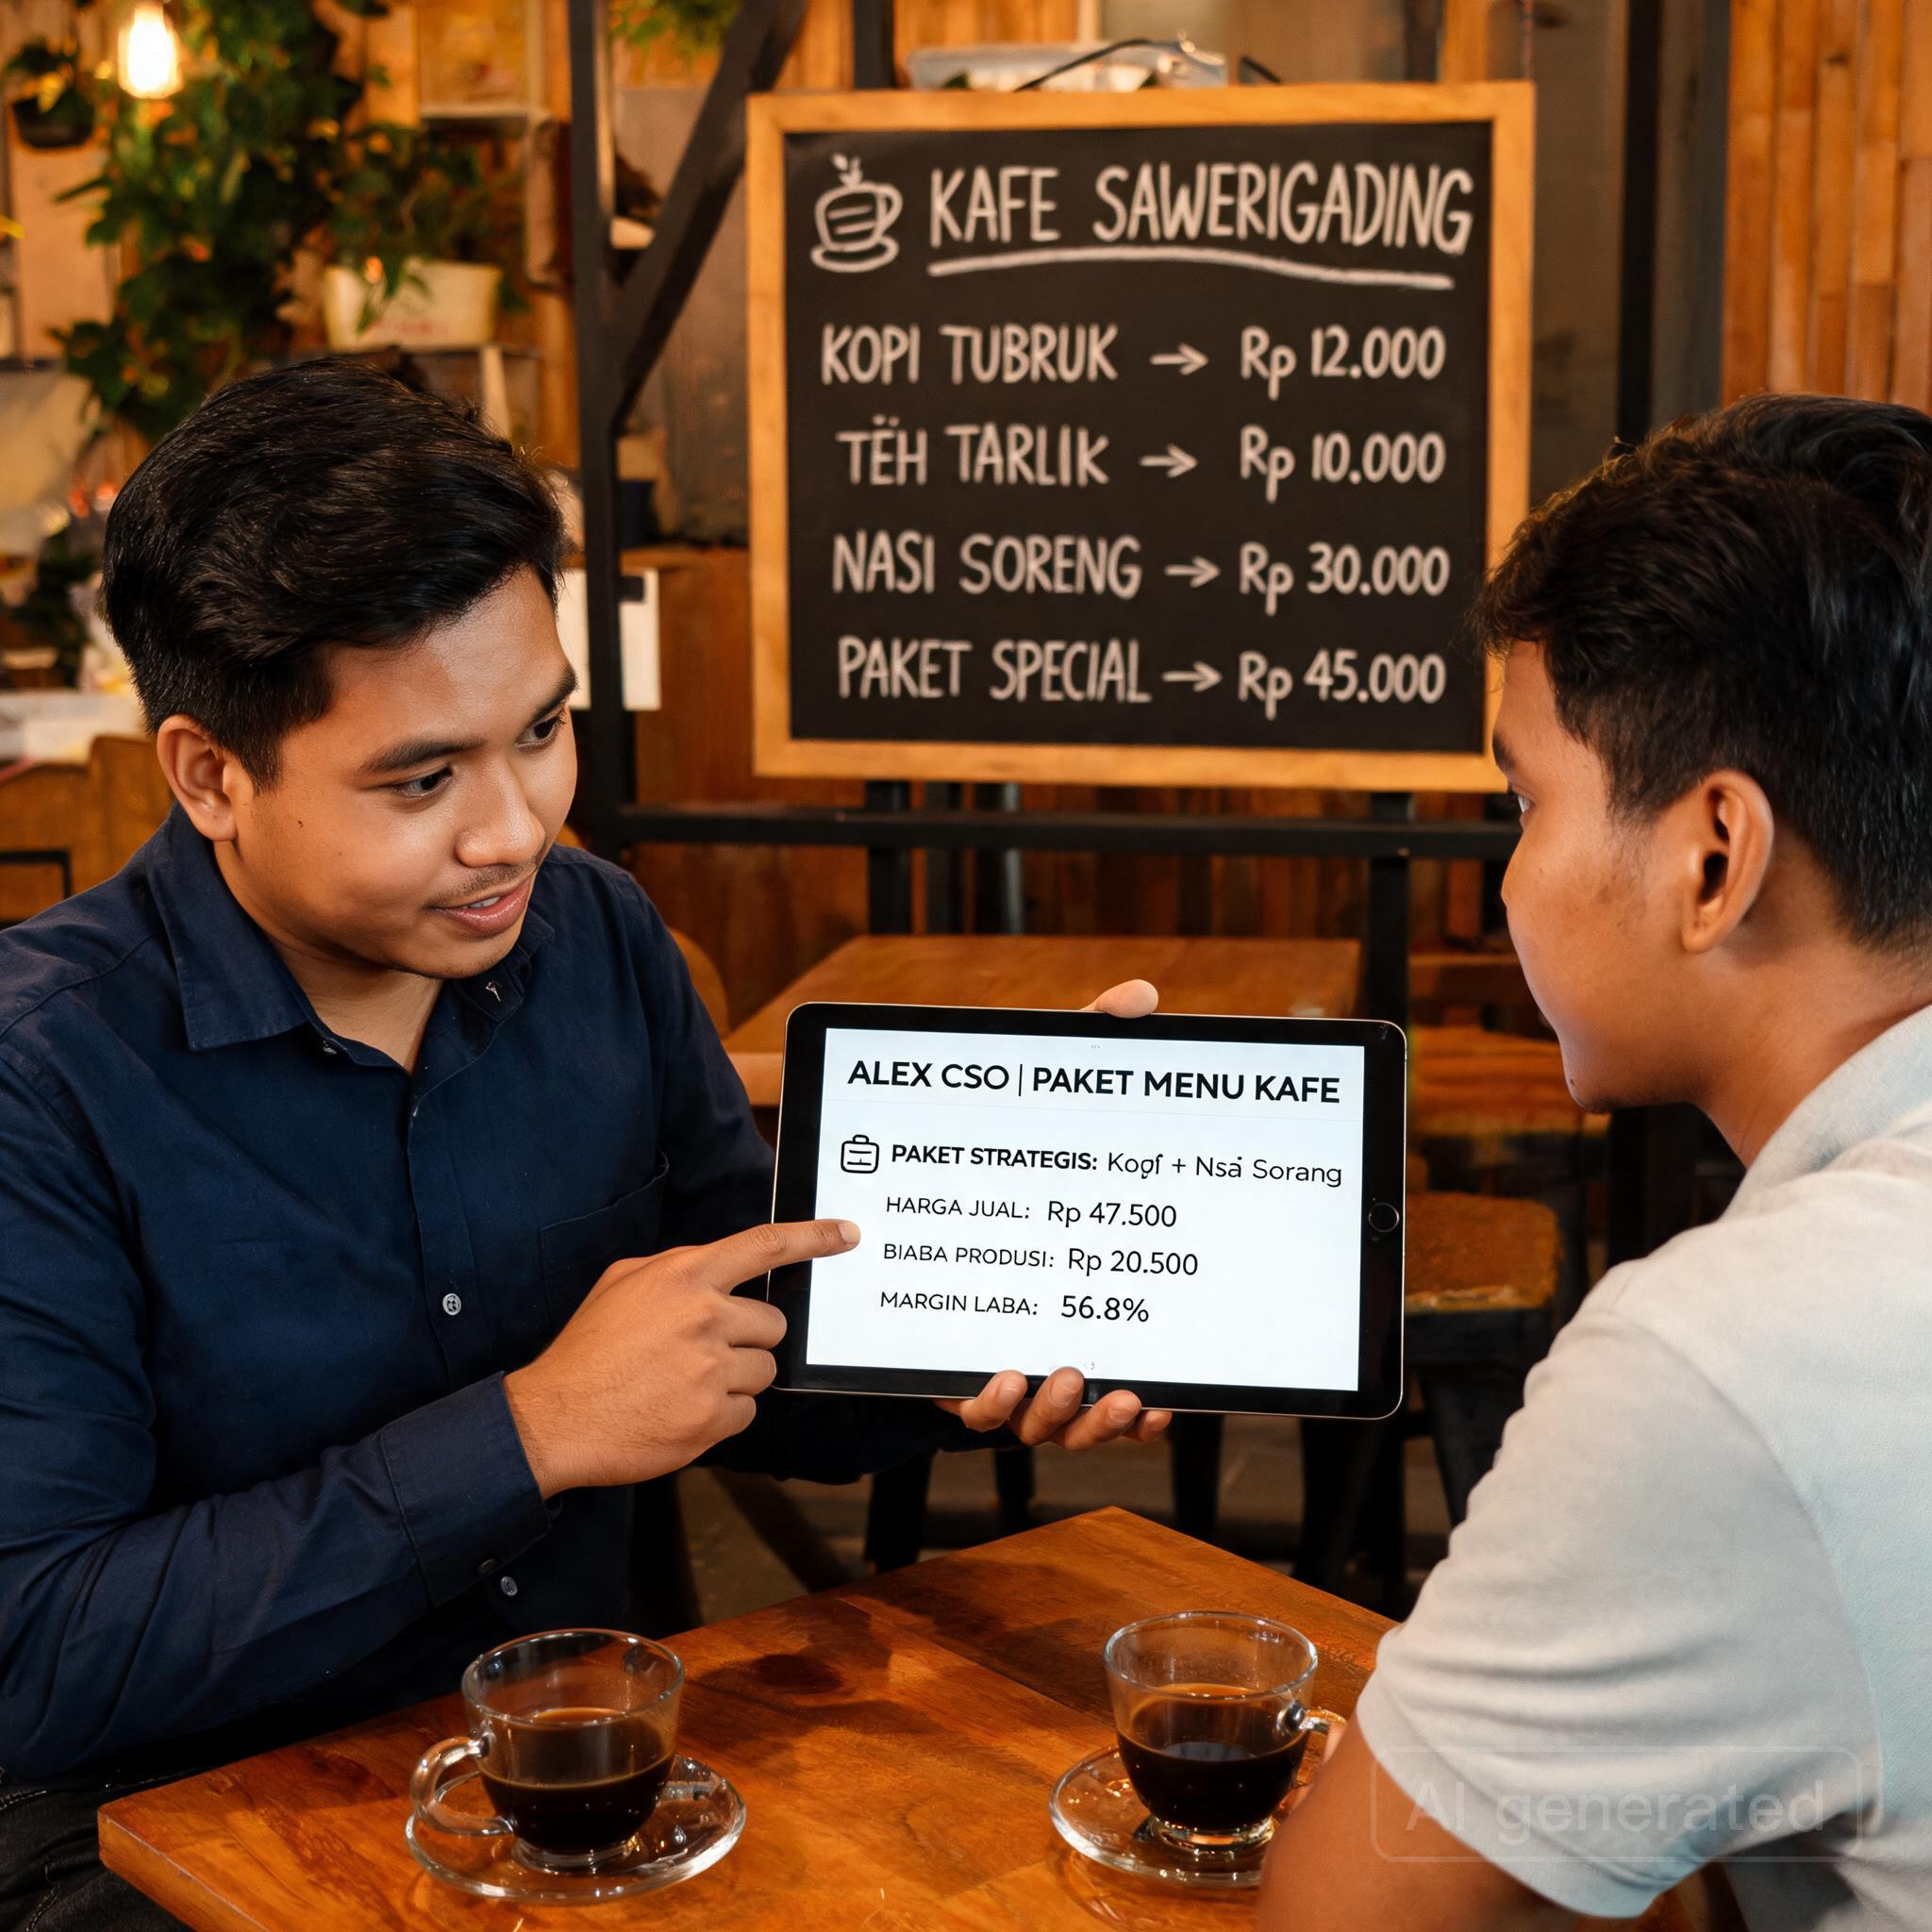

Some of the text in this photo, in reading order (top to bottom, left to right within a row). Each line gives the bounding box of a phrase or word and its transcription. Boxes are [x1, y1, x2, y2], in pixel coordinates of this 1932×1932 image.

[931, 161, 1473, 255] KAFE SAWERIGADING
[821, 324, 1446, 401] KOPI TUBRUK Rp 12.000
[945, 423, 1109, 486] TARLIK
[1241, 425, 1295, 503] Rp
[1311, 431, 1446, 484] 10.000
[832, 530, 1451, 616] NASI SORENG Rp 30.000
[838, 638, 1446, 720] PAKET SPECIAL Rp 45.000
[847, 1059, 934, 1089] ALEX
[941, 1063, 1010, 1091] CSO
[1032, 1066, 1135, 1095] PAKET
[1143, 1070, 1245, 1100] MENU
[1255, 1074, 1341, 1104] KAFE
[891, 1143, 965, 1166] PAKET
[970, 1147, 1098, 1172] STRATEGIS:
[1252, 1158, 1343, 1189] Sorang
[886, 1196, 1177, 1228] HARGA JUAL: Rp 47.500
[883, 1243, 1198, 1277] BIABA PRODUSI: Rp 20.500
[880, 1291, 1150, 1323] MARGIN LABA: 56.8%
